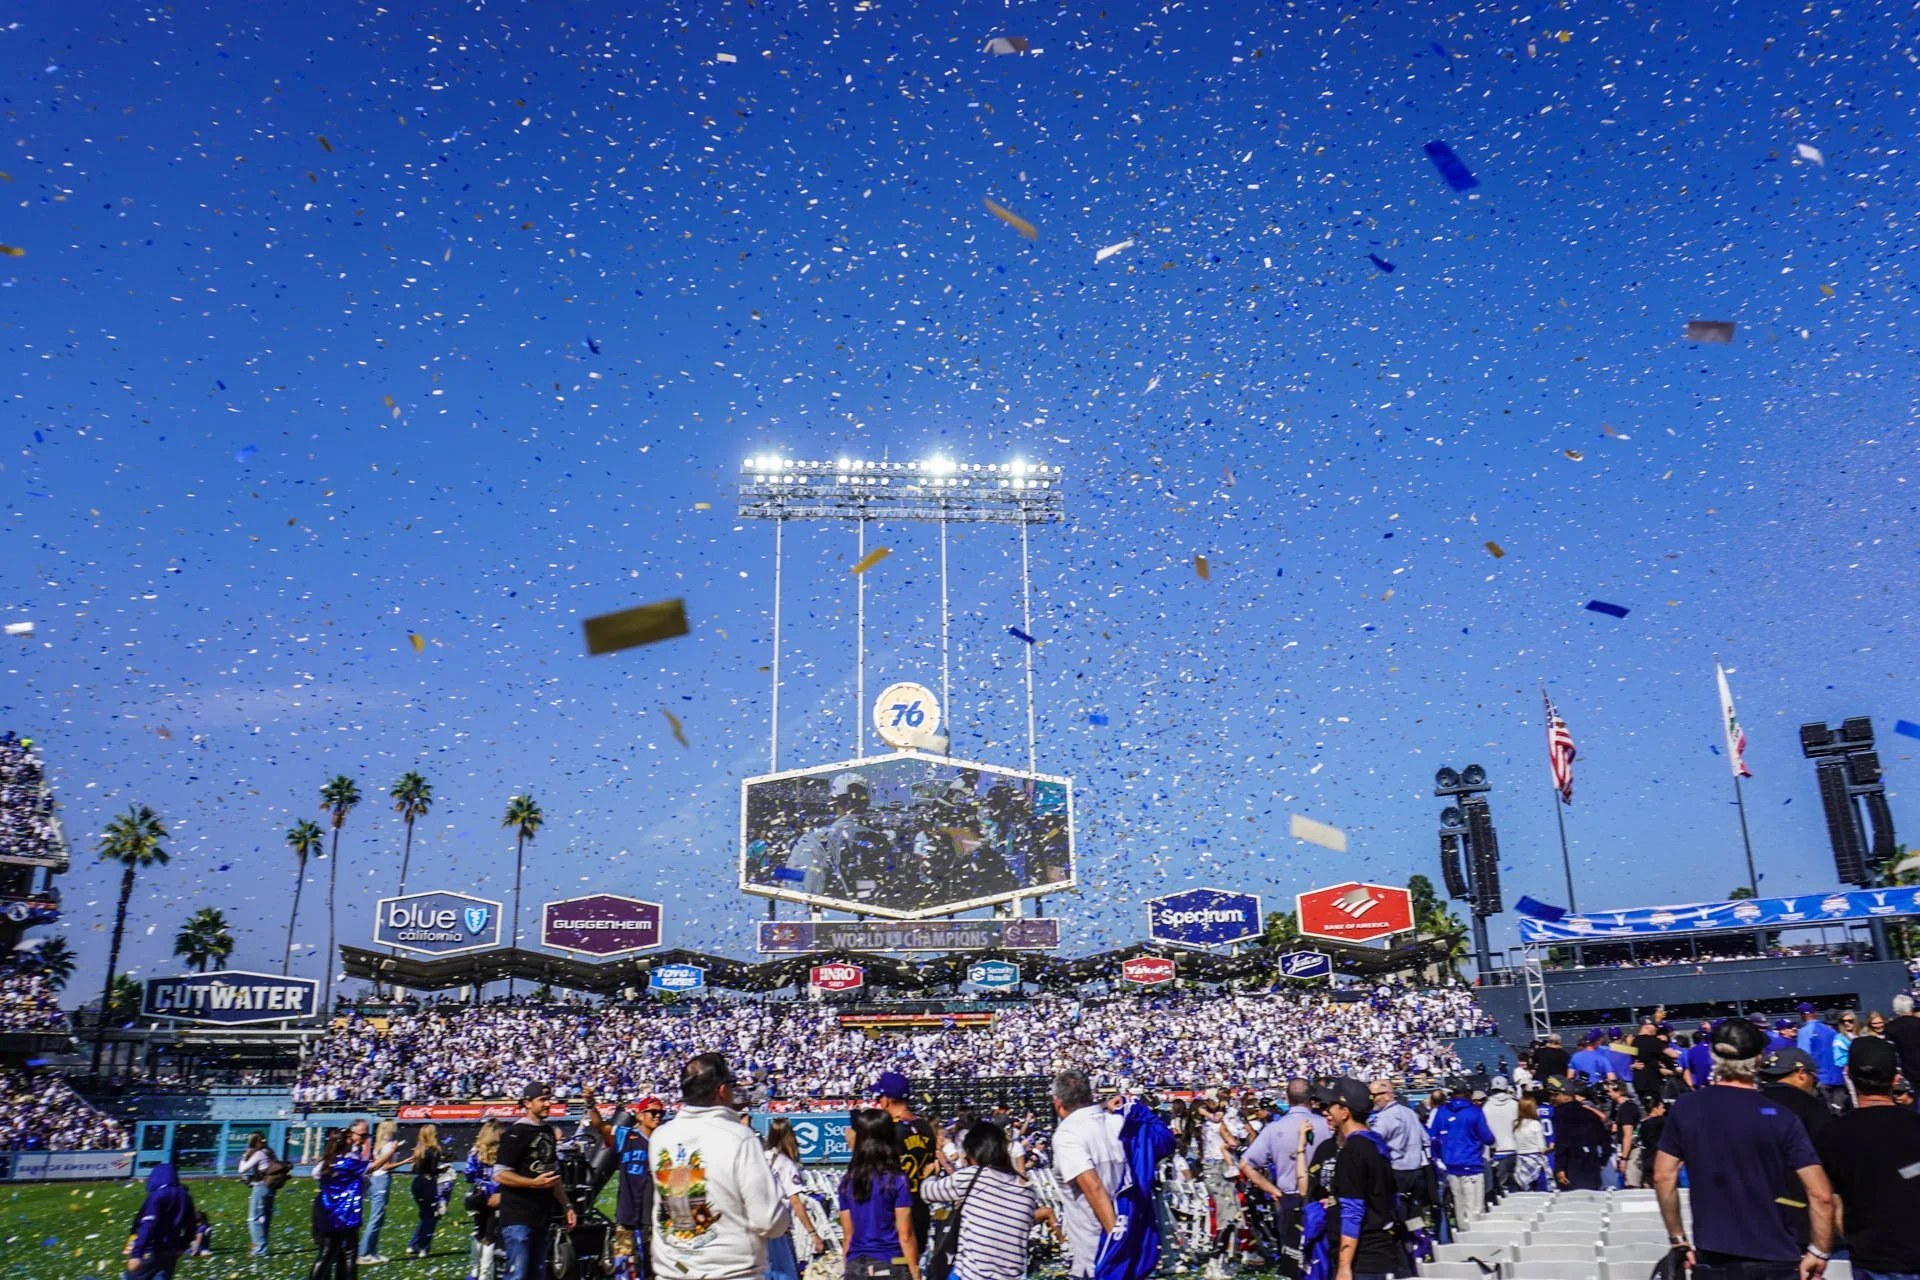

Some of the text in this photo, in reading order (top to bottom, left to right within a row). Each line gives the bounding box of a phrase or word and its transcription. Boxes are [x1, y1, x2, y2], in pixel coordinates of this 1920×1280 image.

[890, 700, 925, 728] 76
[389, 903, 457, 929] blue
[553, 919, 653, 930] GUGGENHEIM
[1161, 908, 1244, 927] Spectrum
[398, 929, 464, 942] california
[831, 931, 989, 948] WORLD CHAMPIONS
[154, 985, 303, 1010] CUTWATER
[63, 1162, 109, 1171] AMERICA
